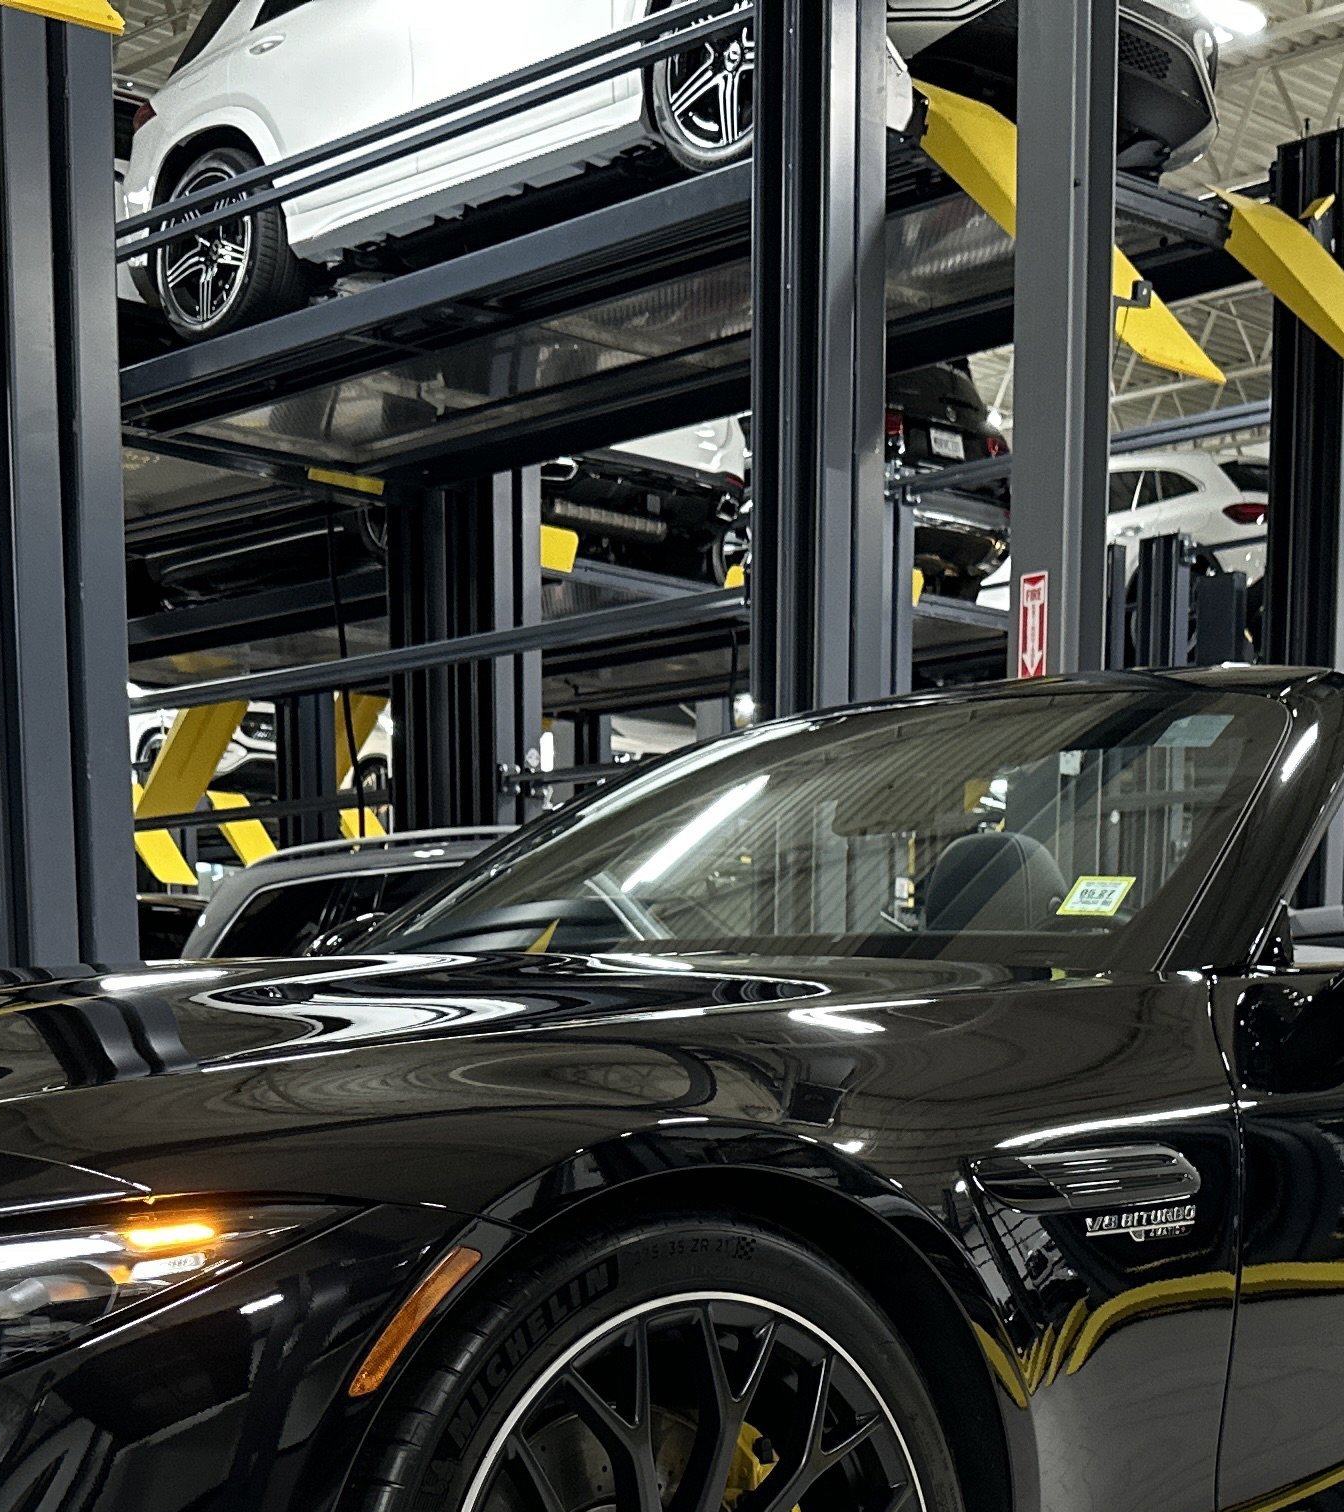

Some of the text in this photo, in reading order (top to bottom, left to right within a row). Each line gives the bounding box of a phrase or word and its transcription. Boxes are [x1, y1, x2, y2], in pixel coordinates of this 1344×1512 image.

[1085, 1204, 1196, 1231] V8 BITURBO
[690, 1238, 709, 1253] ZR
[447, 1259, 612, 1450] MICHELIN
